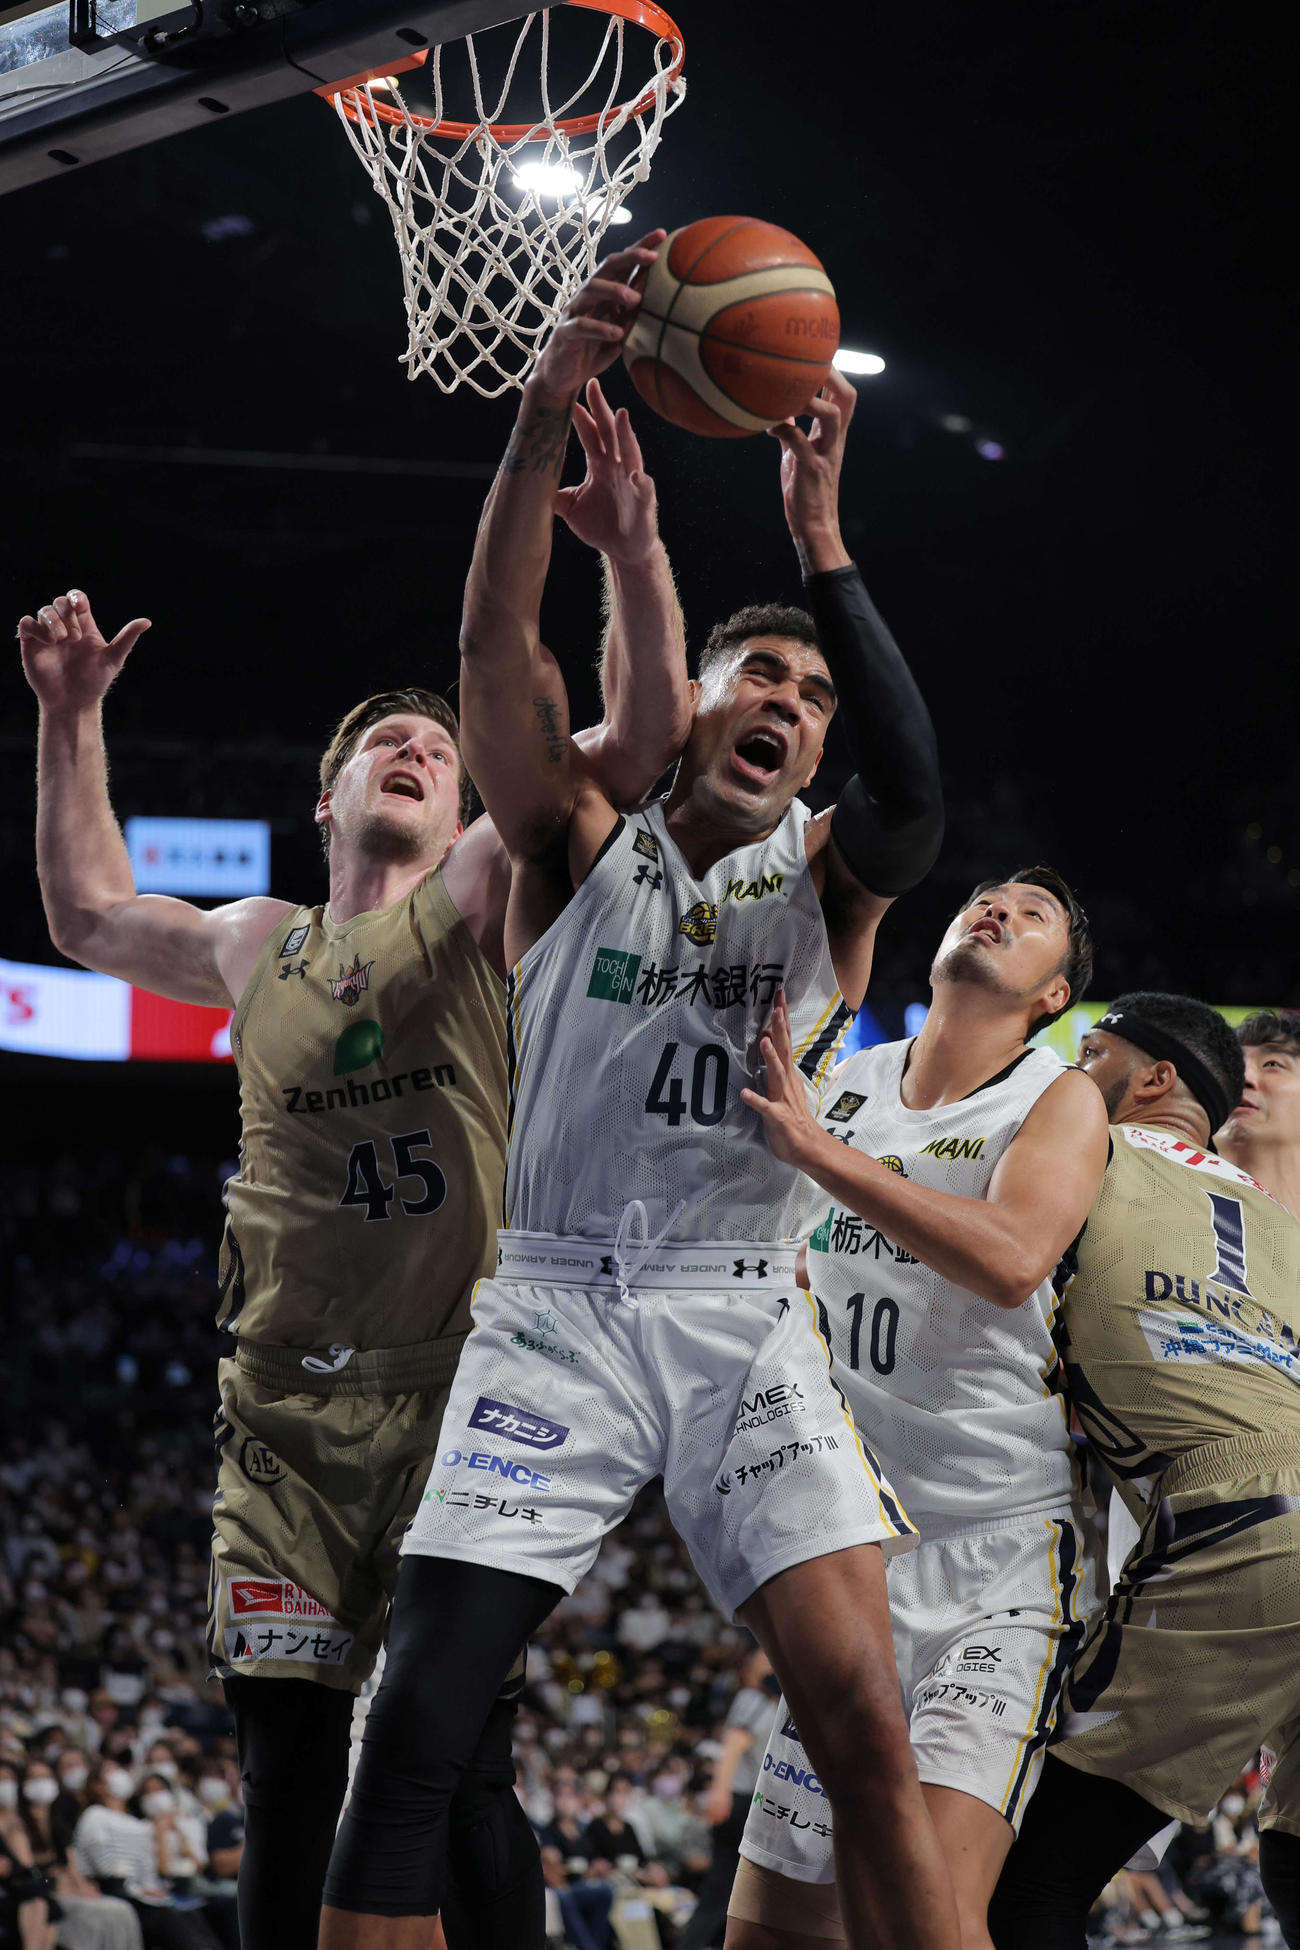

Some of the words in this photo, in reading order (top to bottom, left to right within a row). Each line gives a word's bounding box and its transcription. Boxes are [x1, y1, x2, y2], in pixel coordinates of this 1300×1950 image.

[637, 963, 784, 1009] 栃木銀行
[282, 1063, 457, 1114] Zenhoren
[645, 1042, 729, 1127] 40
[338, 1129, 448, 1222] 45
[551, 1256, 594, 1269] UNDER
[1204, 1189, 1258, 1301] 1
[681, 1264, 727, 1273] UNDER
[846, 1292, 900, 1375] 10
[478, 1408, 558, 1443] ナカニシ
[441, 1450, 551, 1492] O-ENCE
[446, 1491, 543, 1524] ニチレキ
[258, 1629, 350, 1661] ナンセイ
